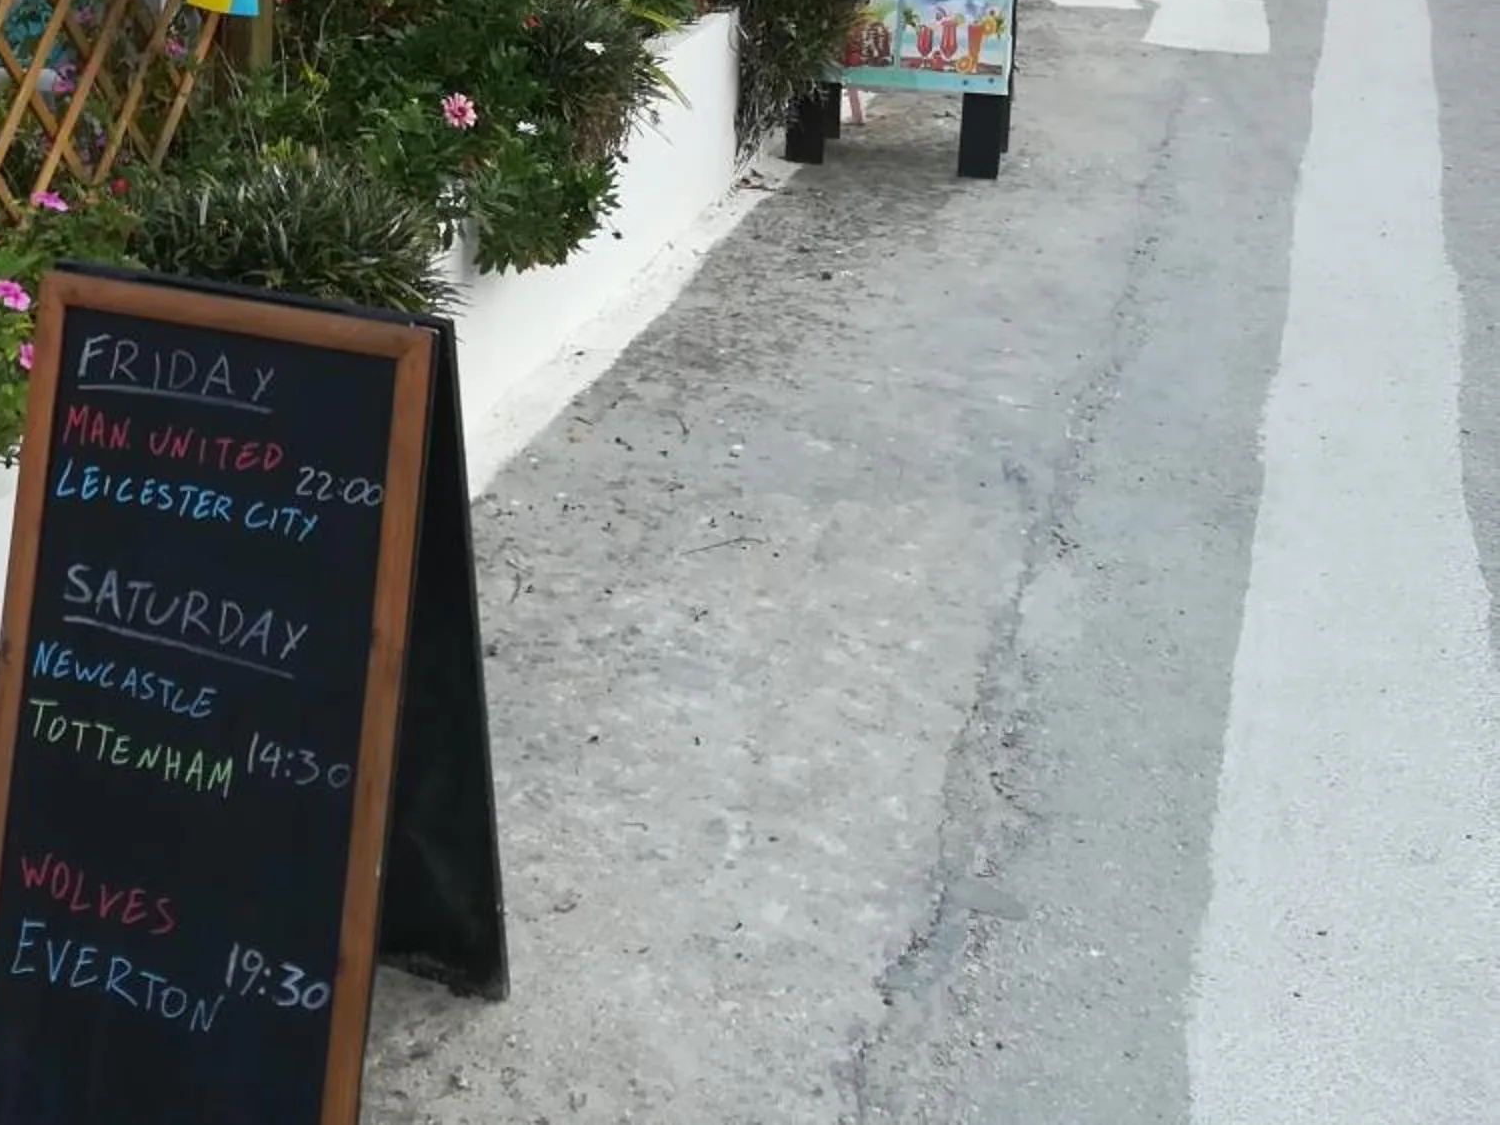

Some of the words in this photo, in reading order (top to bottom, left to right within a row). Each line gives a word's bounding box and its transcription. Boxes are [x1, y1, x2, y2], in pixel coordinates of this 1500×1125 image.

[77, 333, 275, 402] FRIDAY
[149, 426, 284, 471] UNITED
[55, 458, 233, 523] LEICESTER
[244, 501, 319, 542] CITY
[62, 563, 309, 660] SATURDAY
[32, 640, 218, 719] NEWCASTLE
[28, 698, 233, 799] TOTTENHAM
[246, 731, 353, 789] 14:30
[20, 852, 177, 935] WOLVES
[9, 919, 226, 1033] EVERTON
[224, 941, 332, 1011] 19:30
